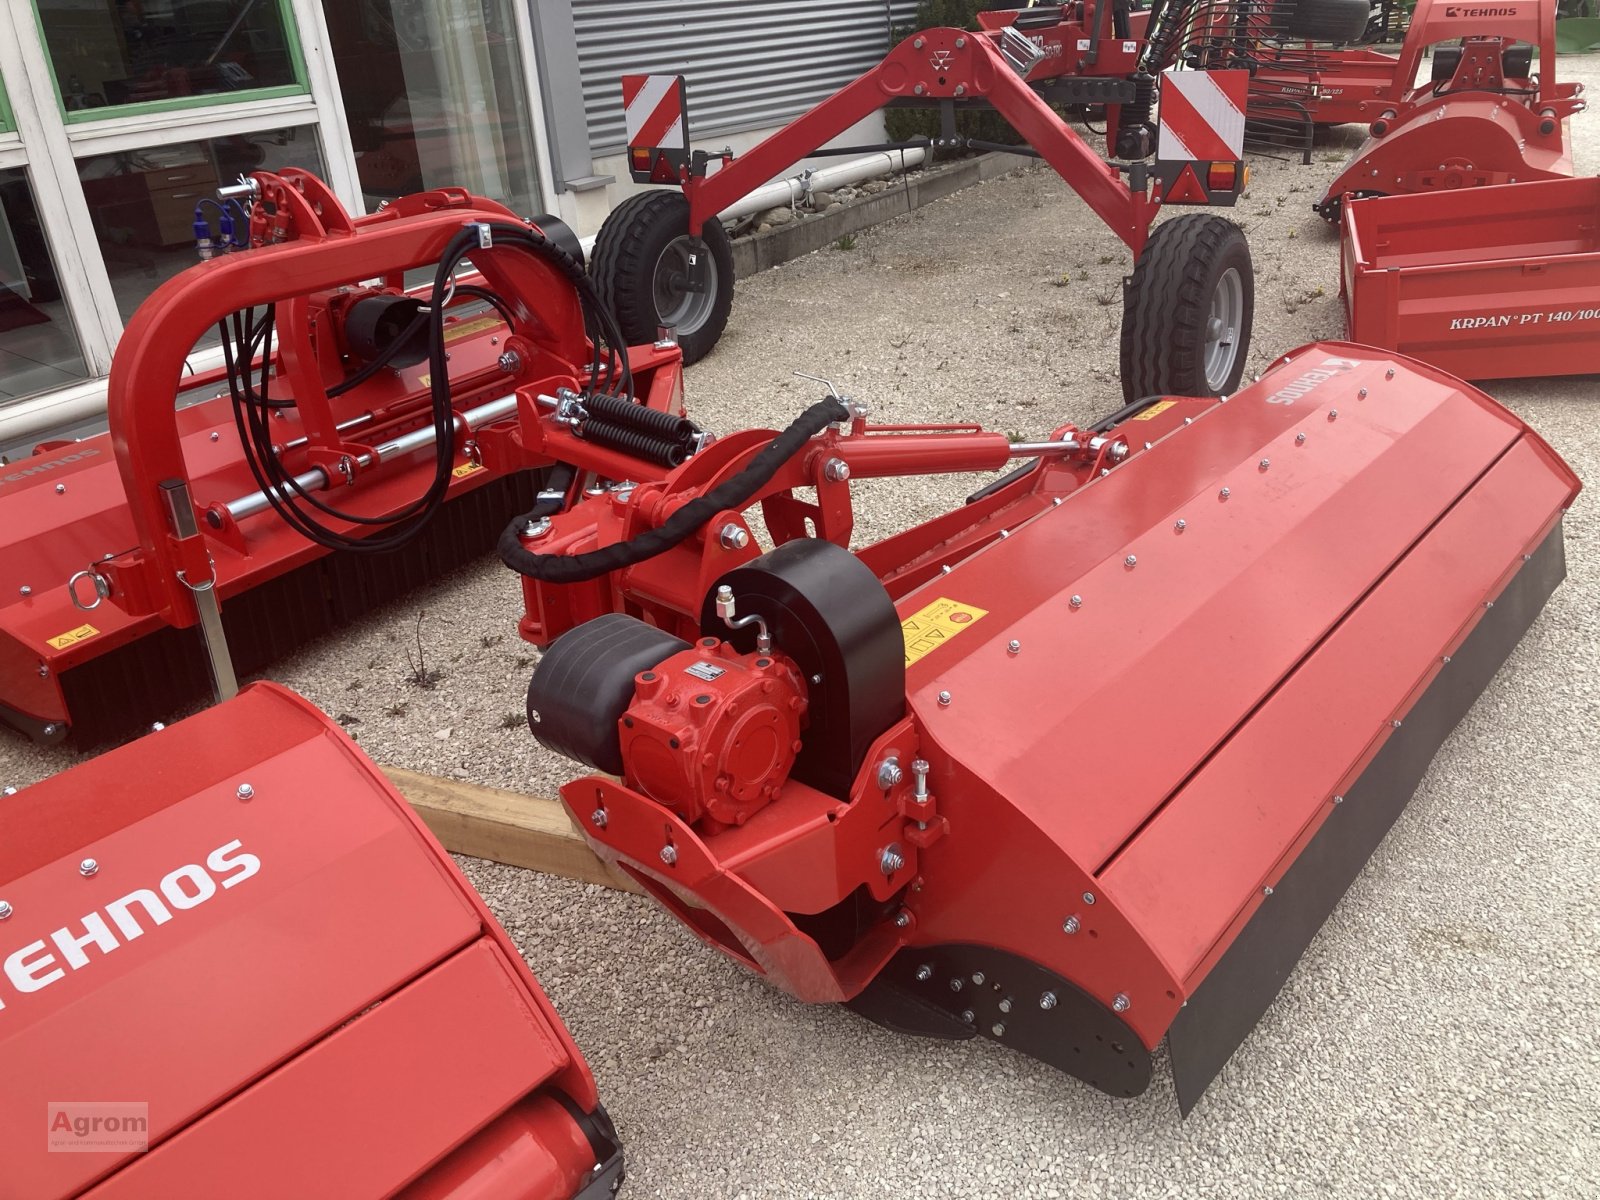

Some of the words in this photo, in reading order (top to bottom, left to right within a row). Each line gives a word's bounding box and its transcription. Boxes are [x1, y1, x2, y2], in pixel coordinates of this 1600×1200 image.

[1463, 8, 1517, 17] TEHNOS
[1520, 313, 1543, 324] PT
[1265, 369, 1338, 405] TEHNOS
[0, 449, 101, 485] EHNOS
[0, 839, 261, 1010] EHNOS
